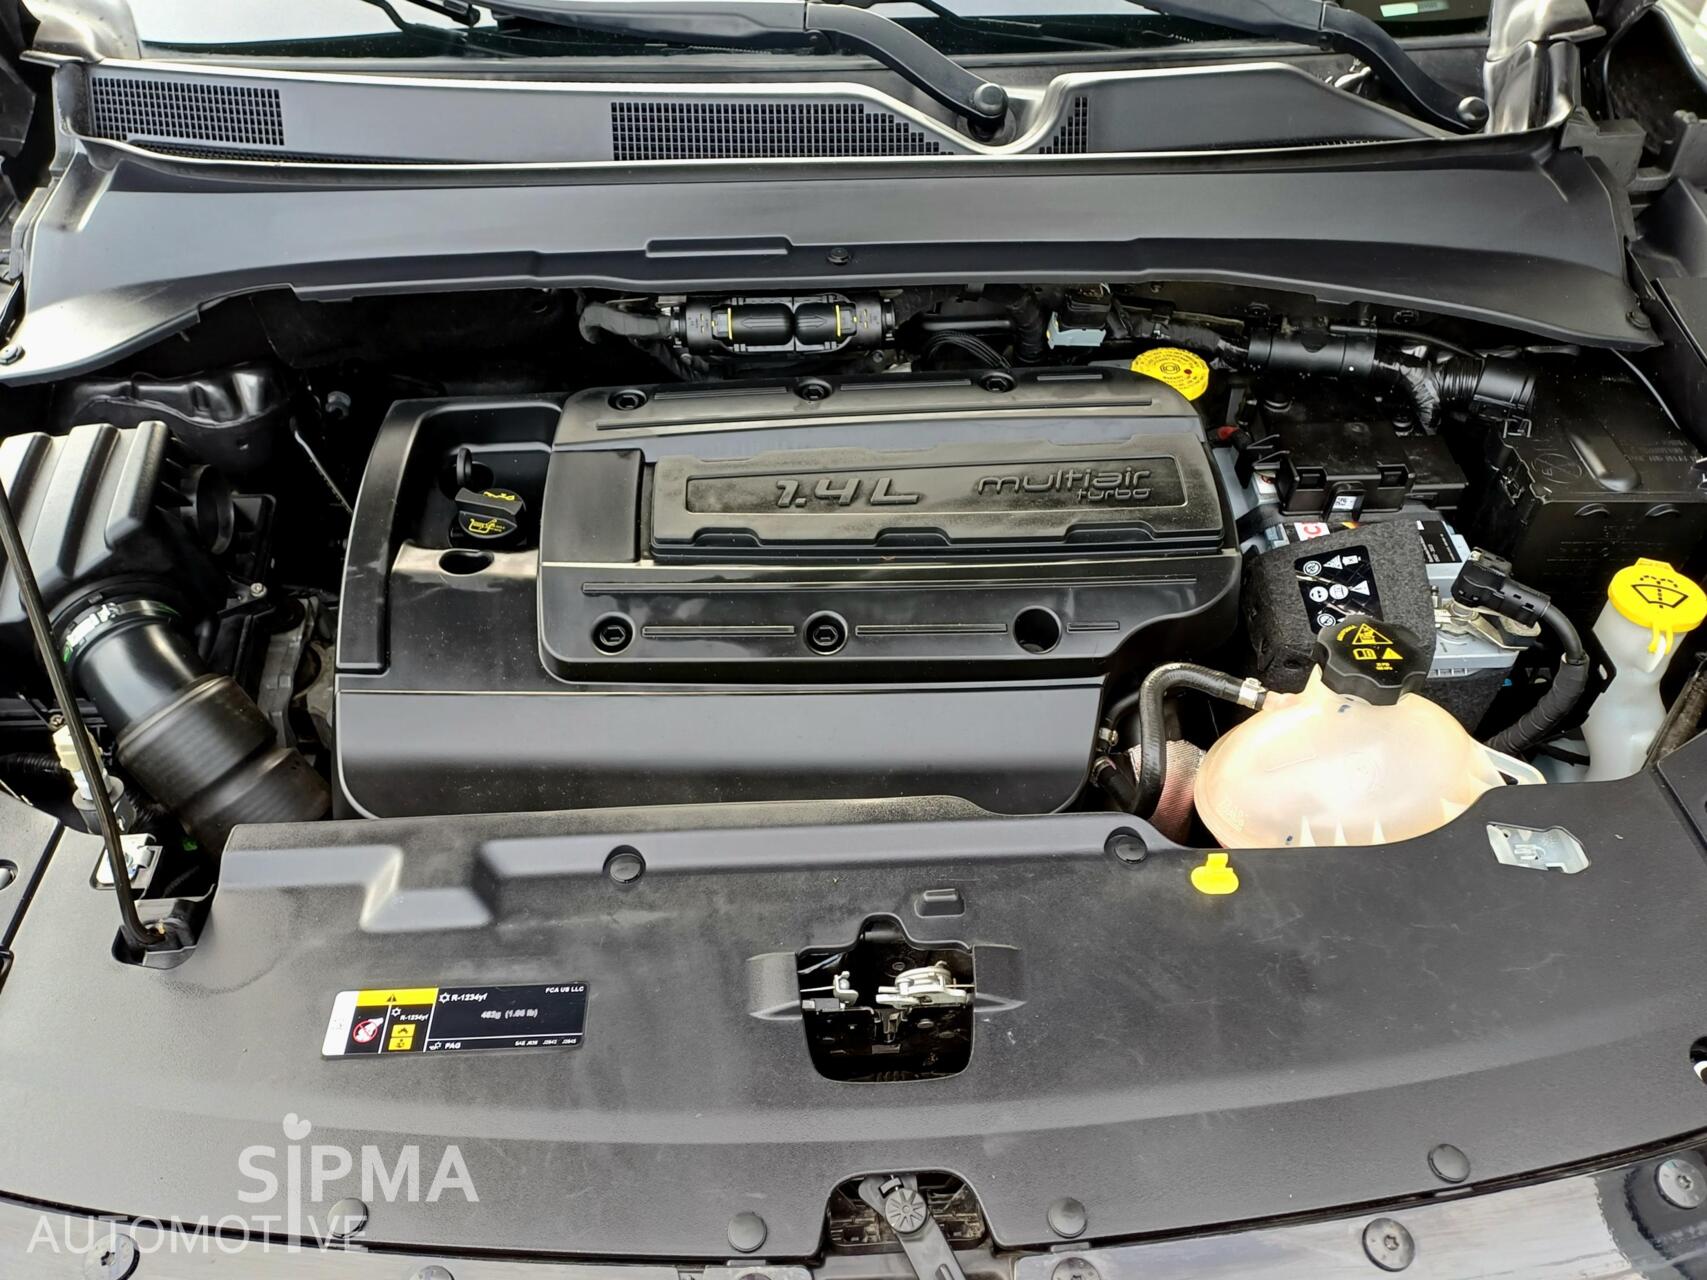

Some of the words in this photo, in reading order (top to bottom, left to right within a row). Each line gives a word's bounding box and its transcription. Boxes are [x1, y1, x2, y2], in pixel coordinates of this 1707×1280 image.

[977, 467, 1153, 496] multiair
[1075, 486, 1152, 501] turbo
[451, 992, 488, 1002] R-1234yf
[444, 1042, 461, 1050] PAG
